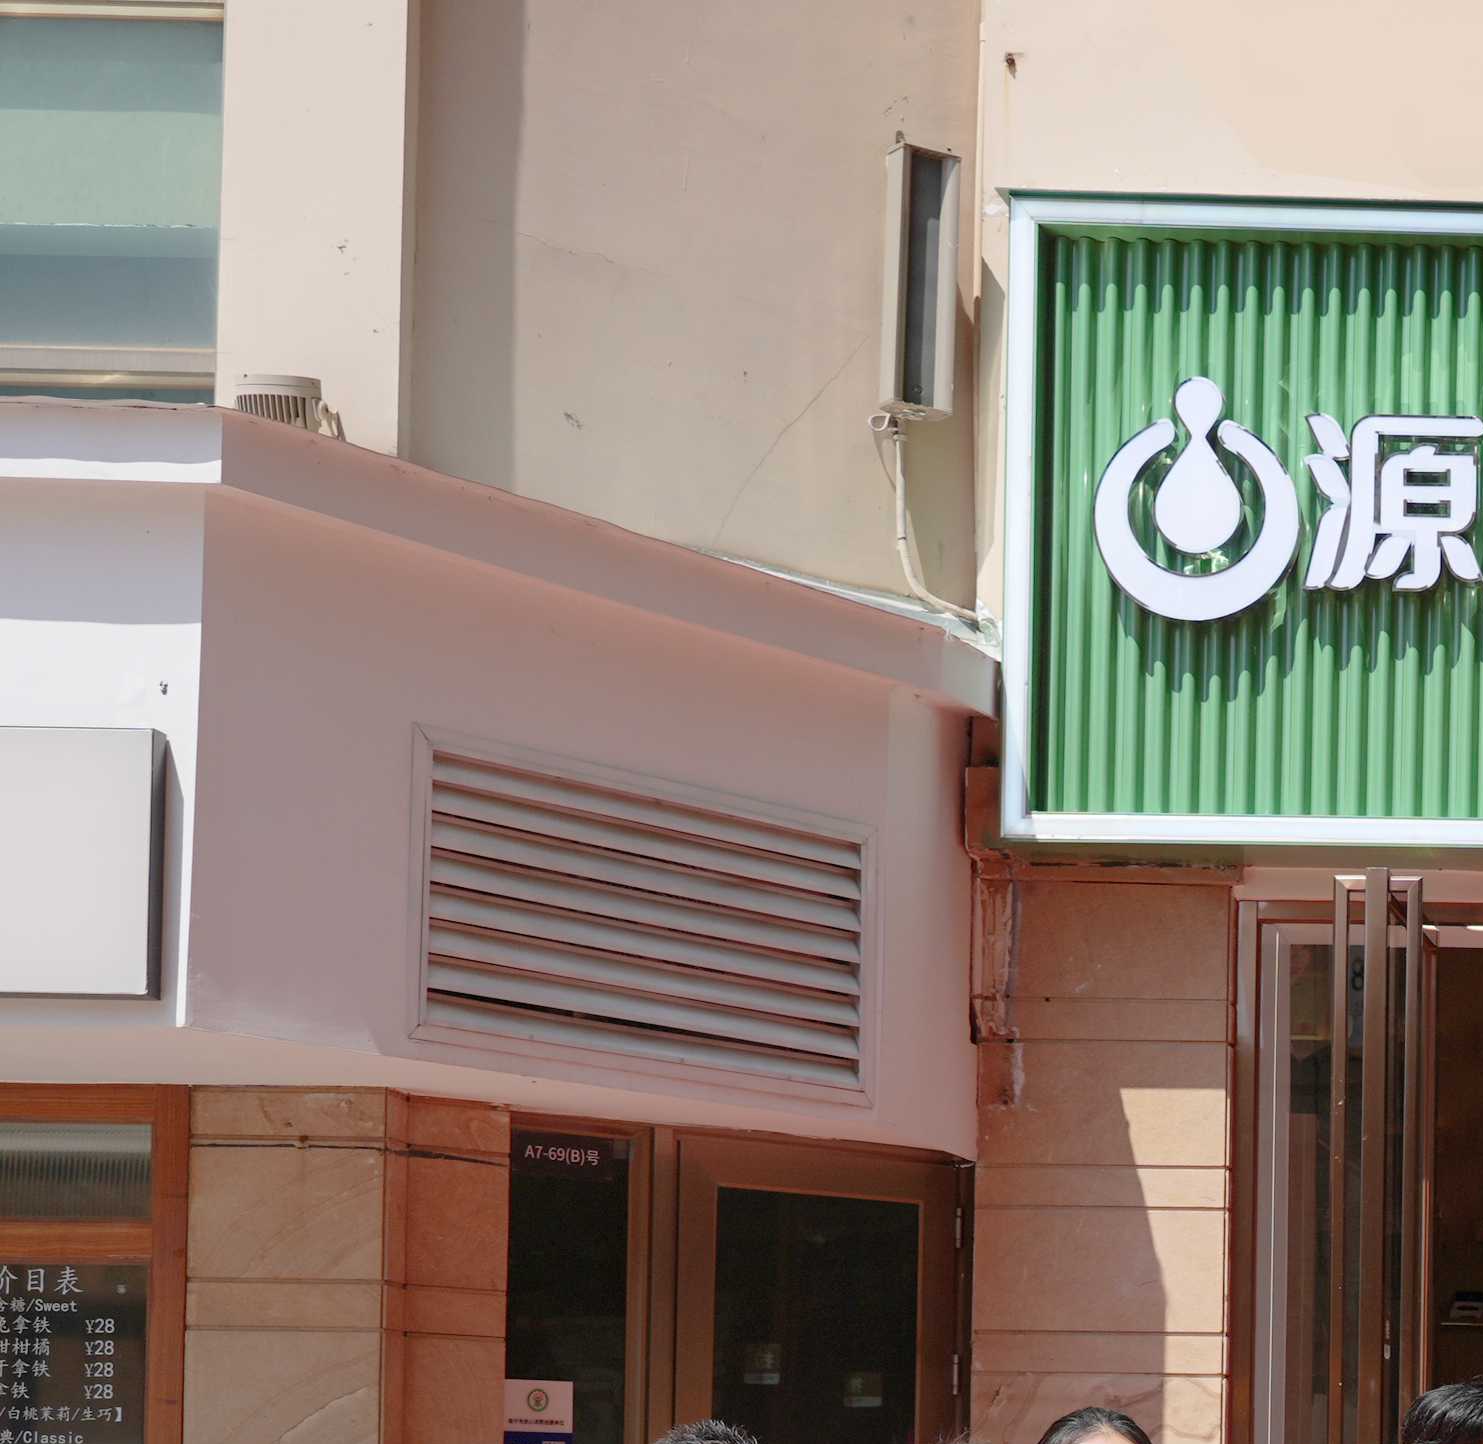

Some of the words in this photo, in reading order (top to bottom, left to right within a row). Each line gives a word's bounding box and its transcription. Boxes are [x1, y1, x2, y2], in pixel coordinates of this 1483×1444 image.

[524, 1144, 600, 1166] A7-69(B)号
[85, 1318, 115, 1334] ¥28
[84, 1340, 115, 1355] ¥28
[84, 1362, 115, 1378] ¥28
[84, 1384, 114, 1399] ¥28
